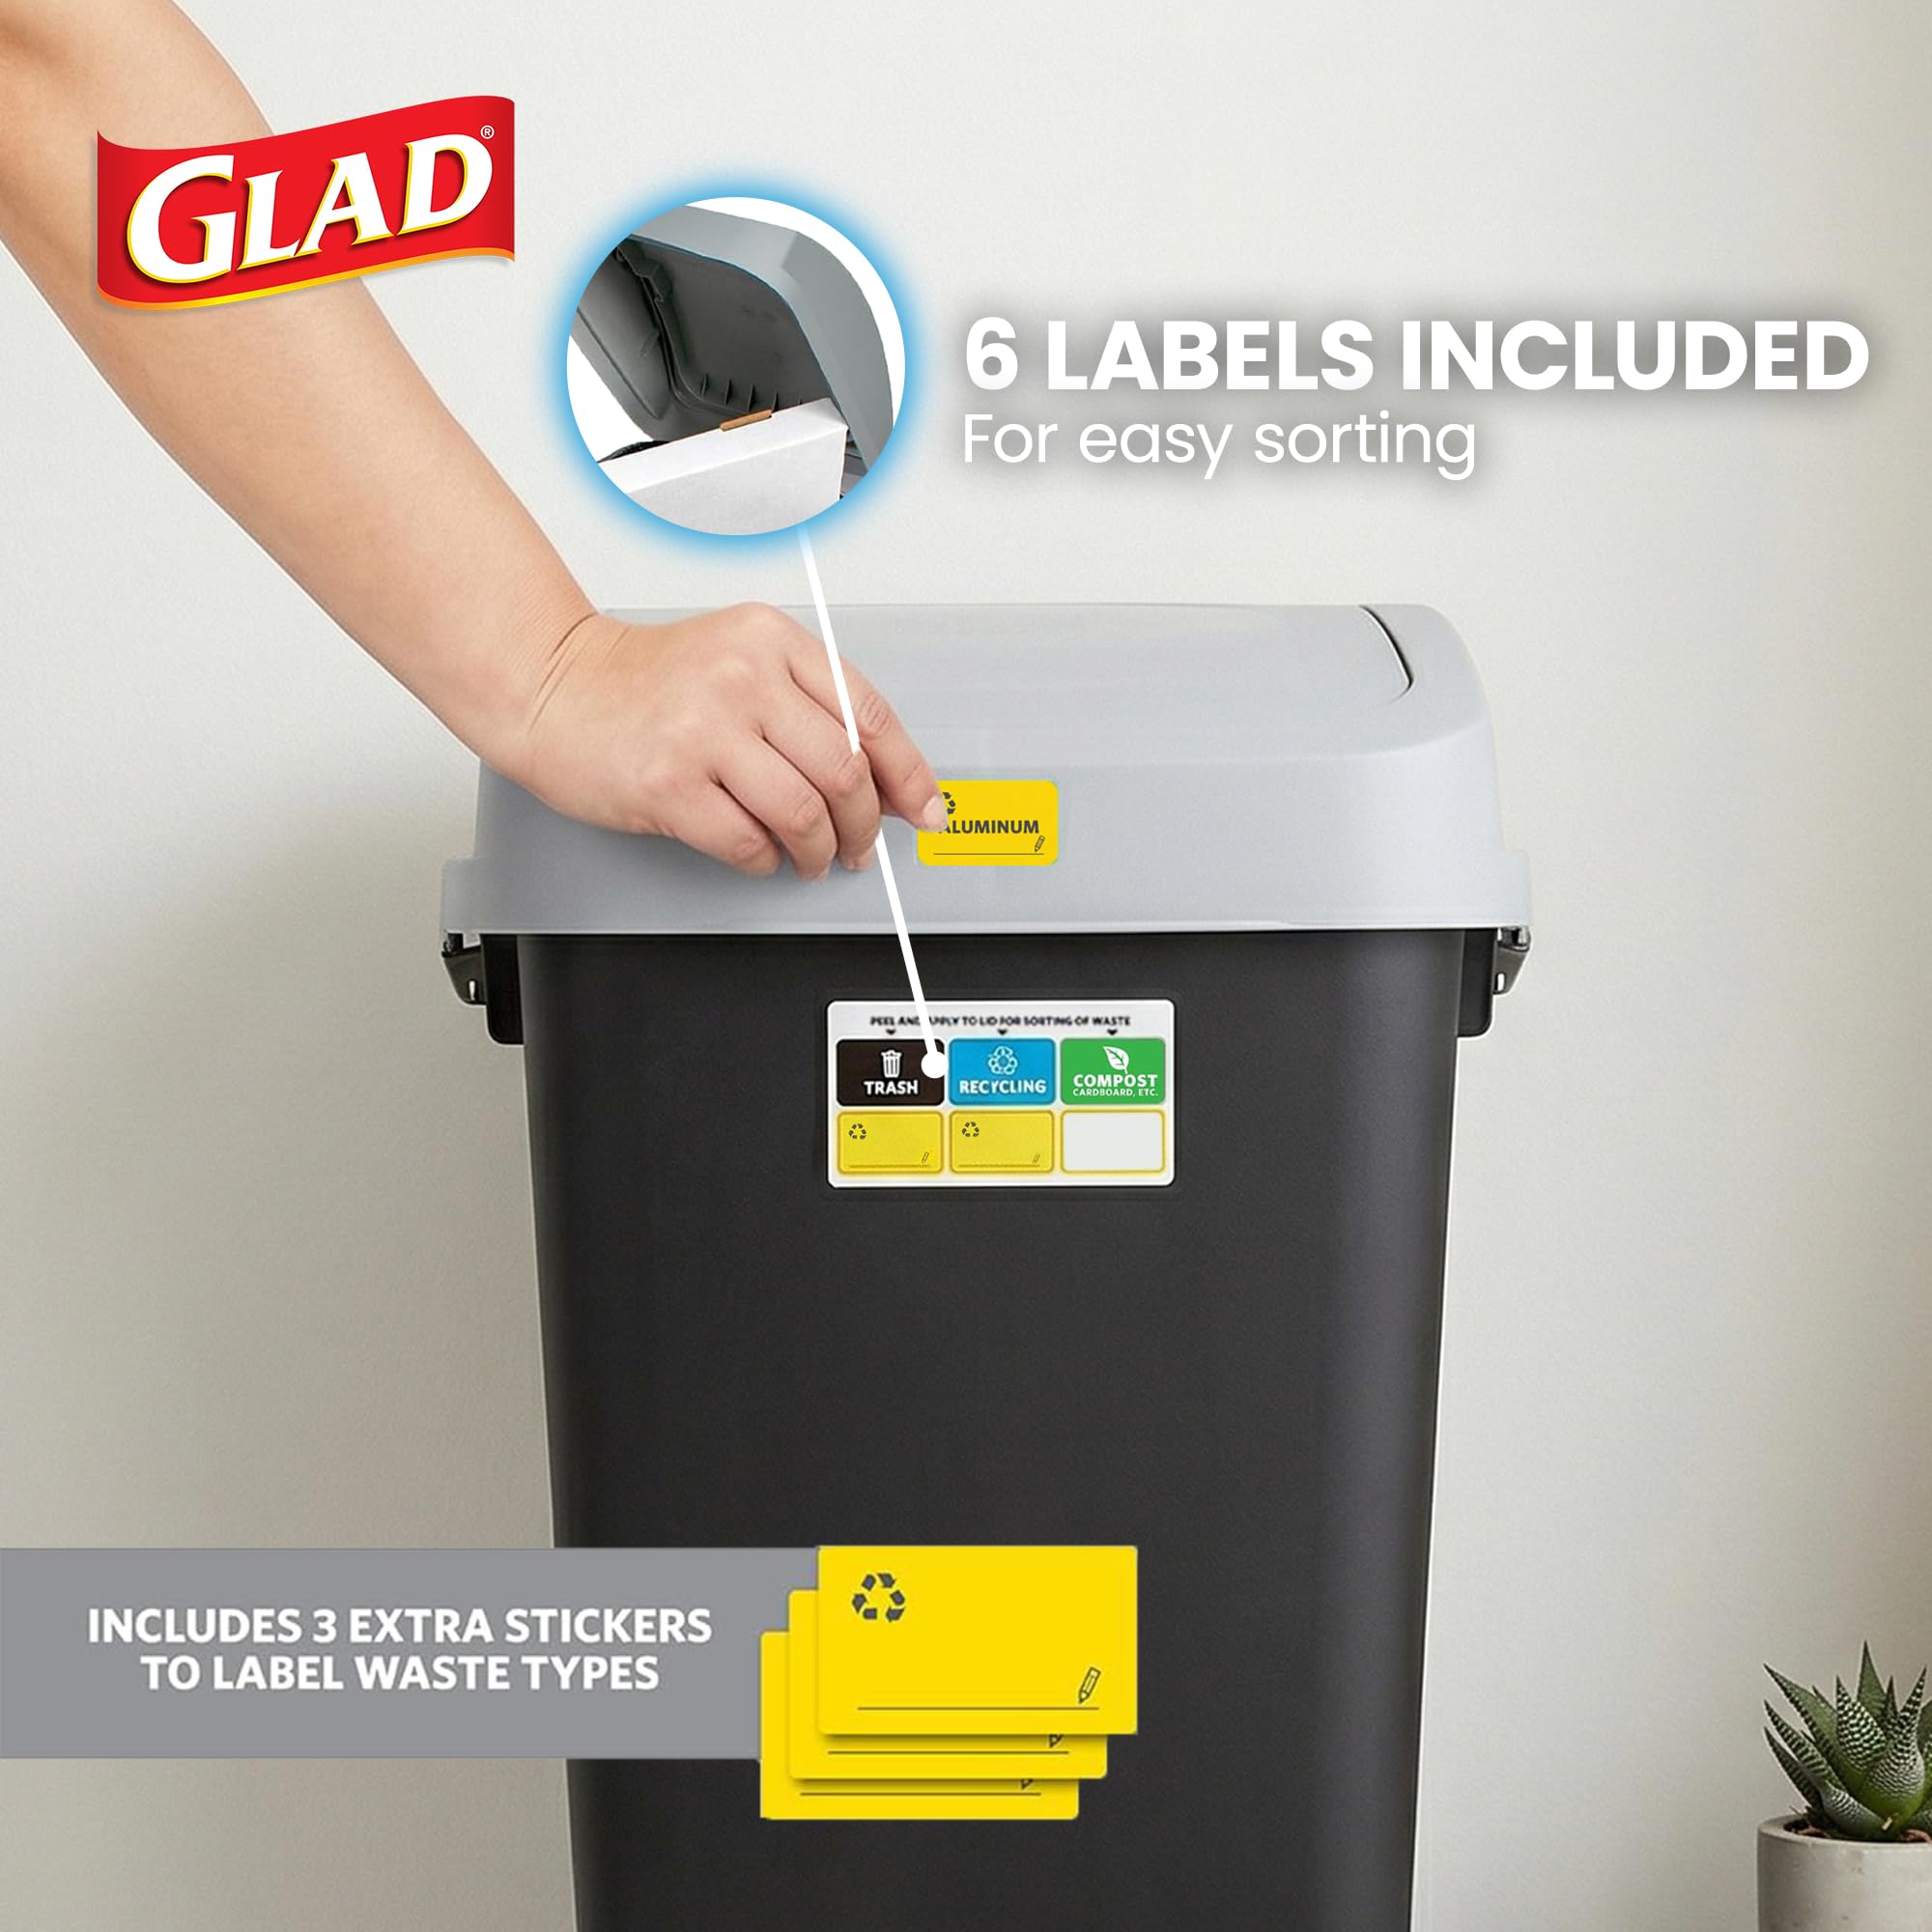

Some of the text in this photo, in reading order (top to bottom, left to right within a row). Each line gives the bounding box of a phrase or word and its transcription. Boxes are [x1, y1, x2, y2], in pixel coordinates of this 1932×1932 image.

[962, 1015, 978, 1026] TO
[1024, 1015, 1072, 1026] SORTING
[1074, 1015, 1089, 1026] OF
[1093, 1015, 1130, 1026] WASTE
[864, 1080, 918, 1095] TRASH
[959, 1079, 1046, 1094] RECYCLING
[1073, 1073, 1158, 1088] COMPOST
[1072, 1088, 1159, 1097] CARDBOARD, ETC.
